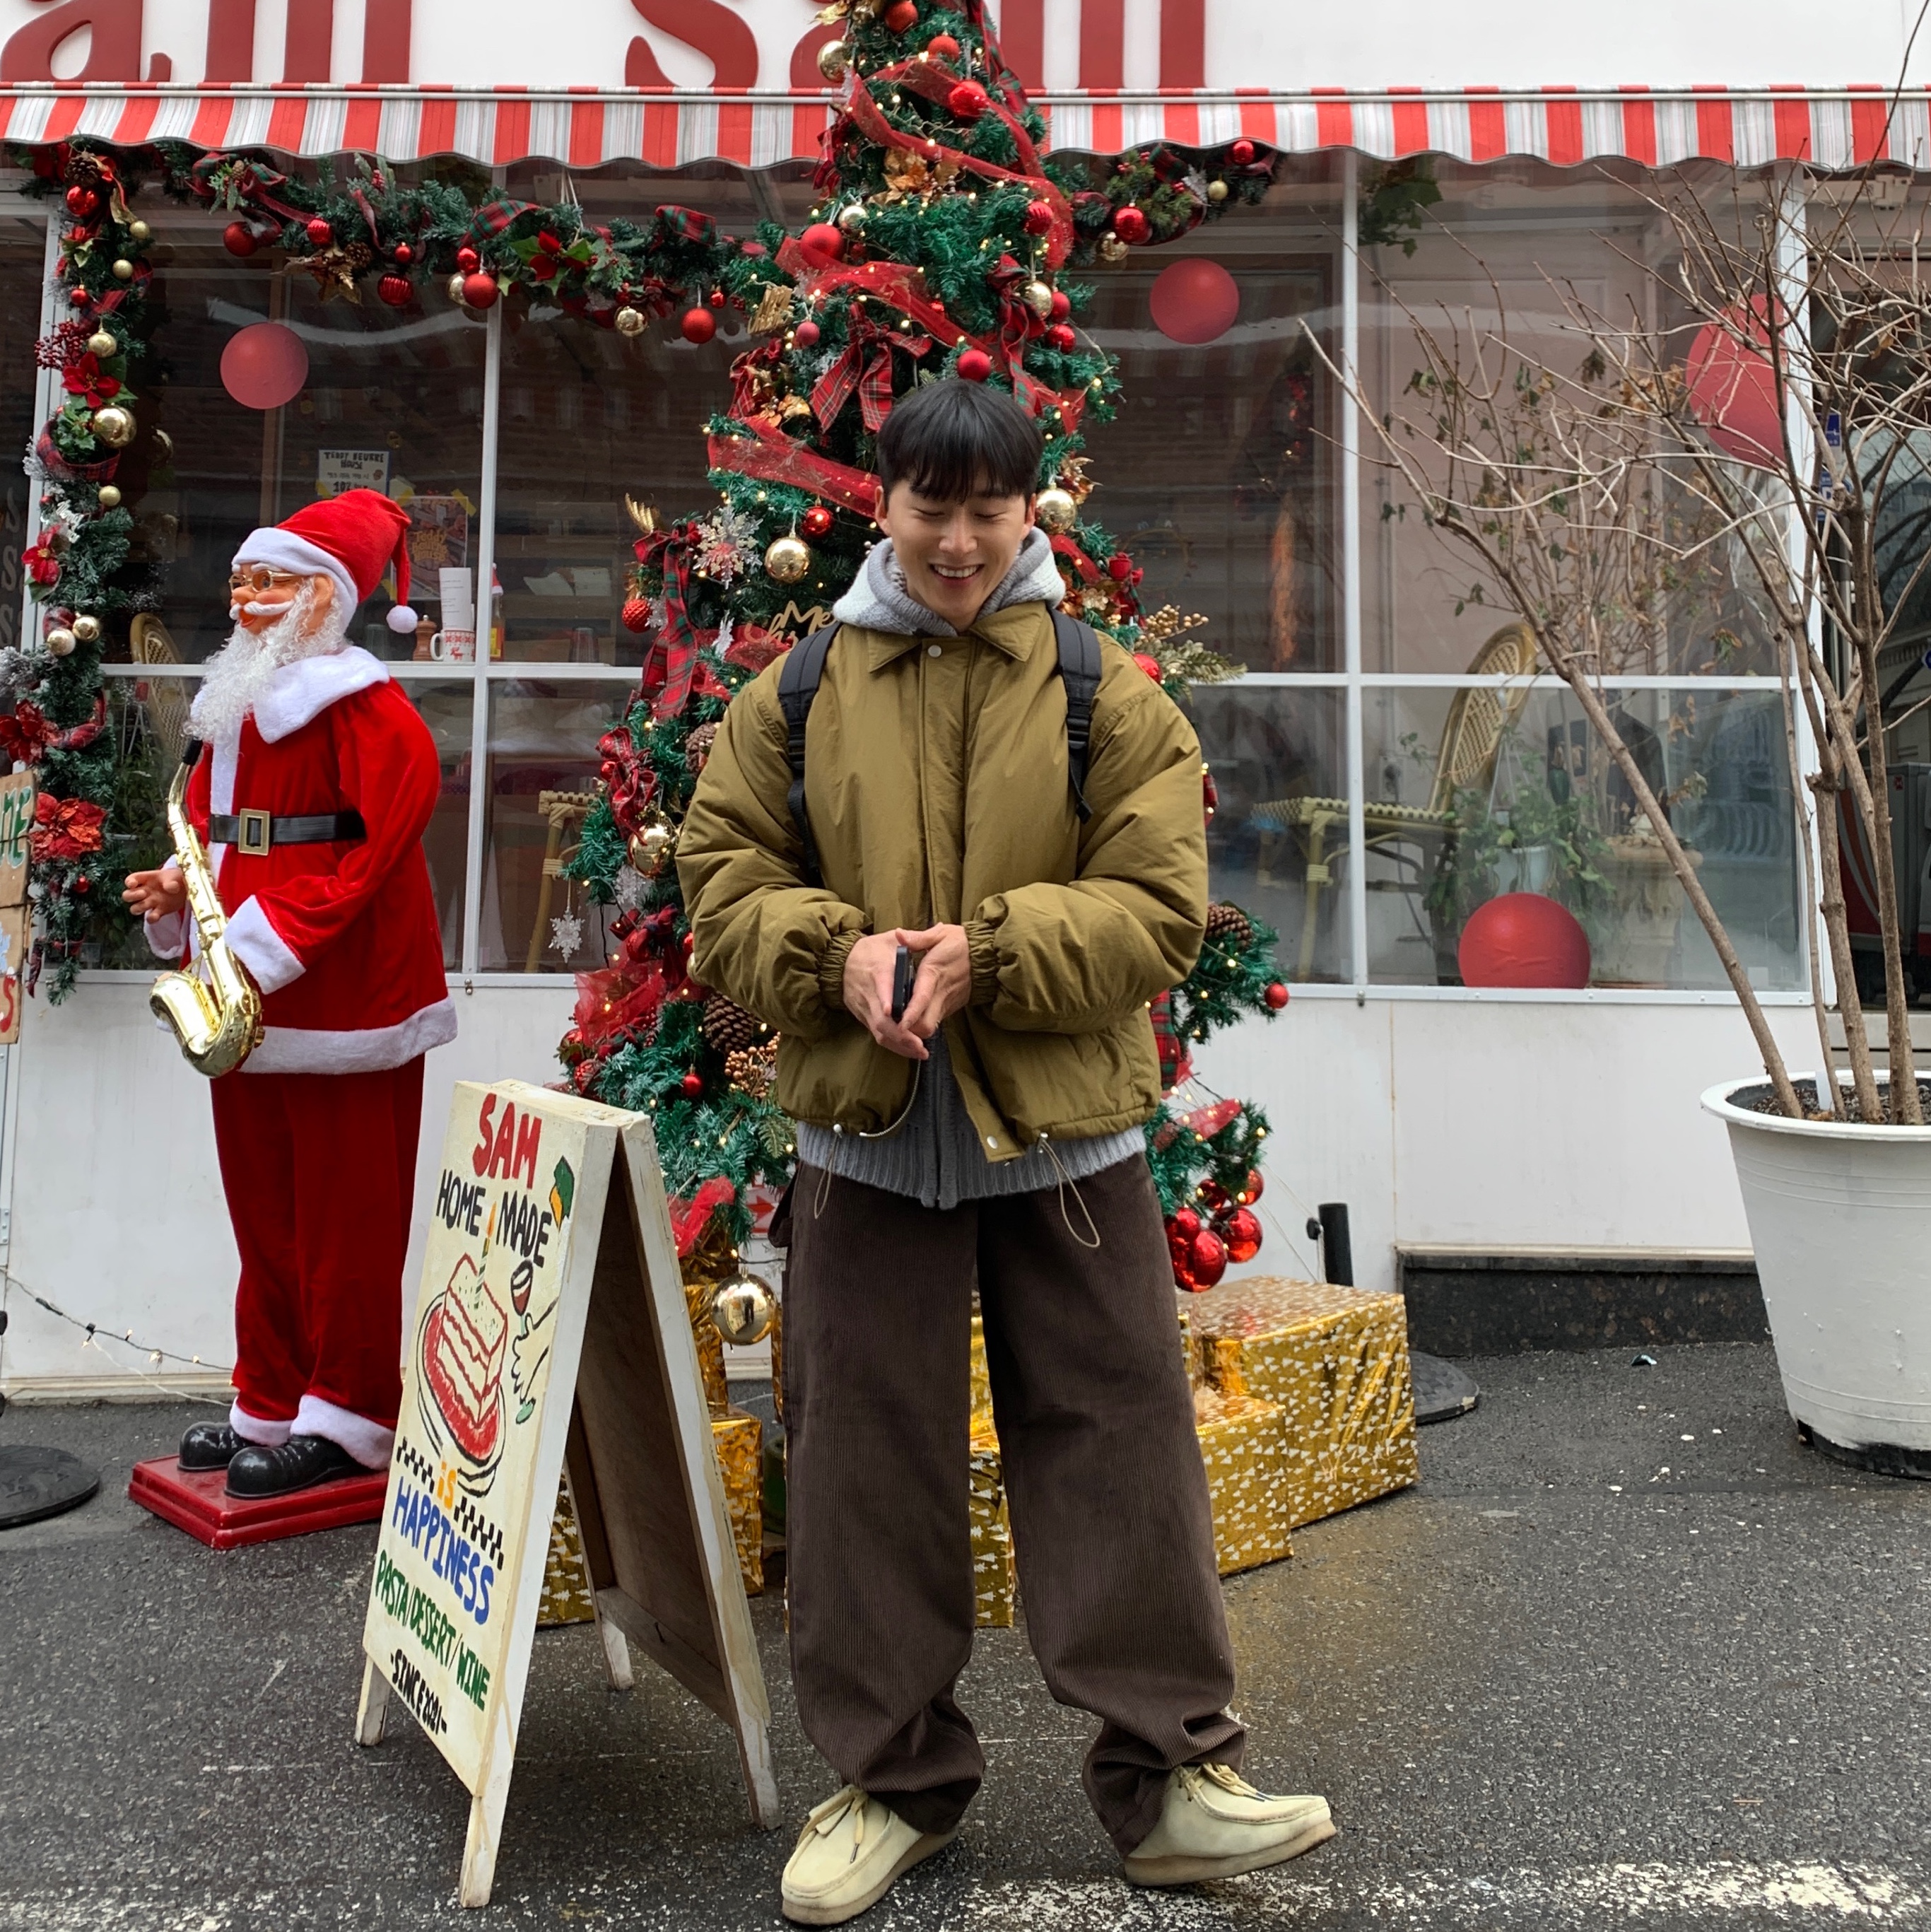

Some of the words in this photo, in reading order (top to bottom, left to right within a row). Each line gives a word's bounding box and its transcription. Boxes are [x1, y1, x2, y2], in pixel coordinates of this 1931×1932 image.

[340, 460, 363, 469] HOUSE
[472, 1093, 542, 1189] SAM
[435, 1169, 486, 1237] HOME
[495, 1190, 553, 1268] MADE
[437, 1462, 458, 1511] is
[392, 1476, 494, 1625] HAPPINESS
